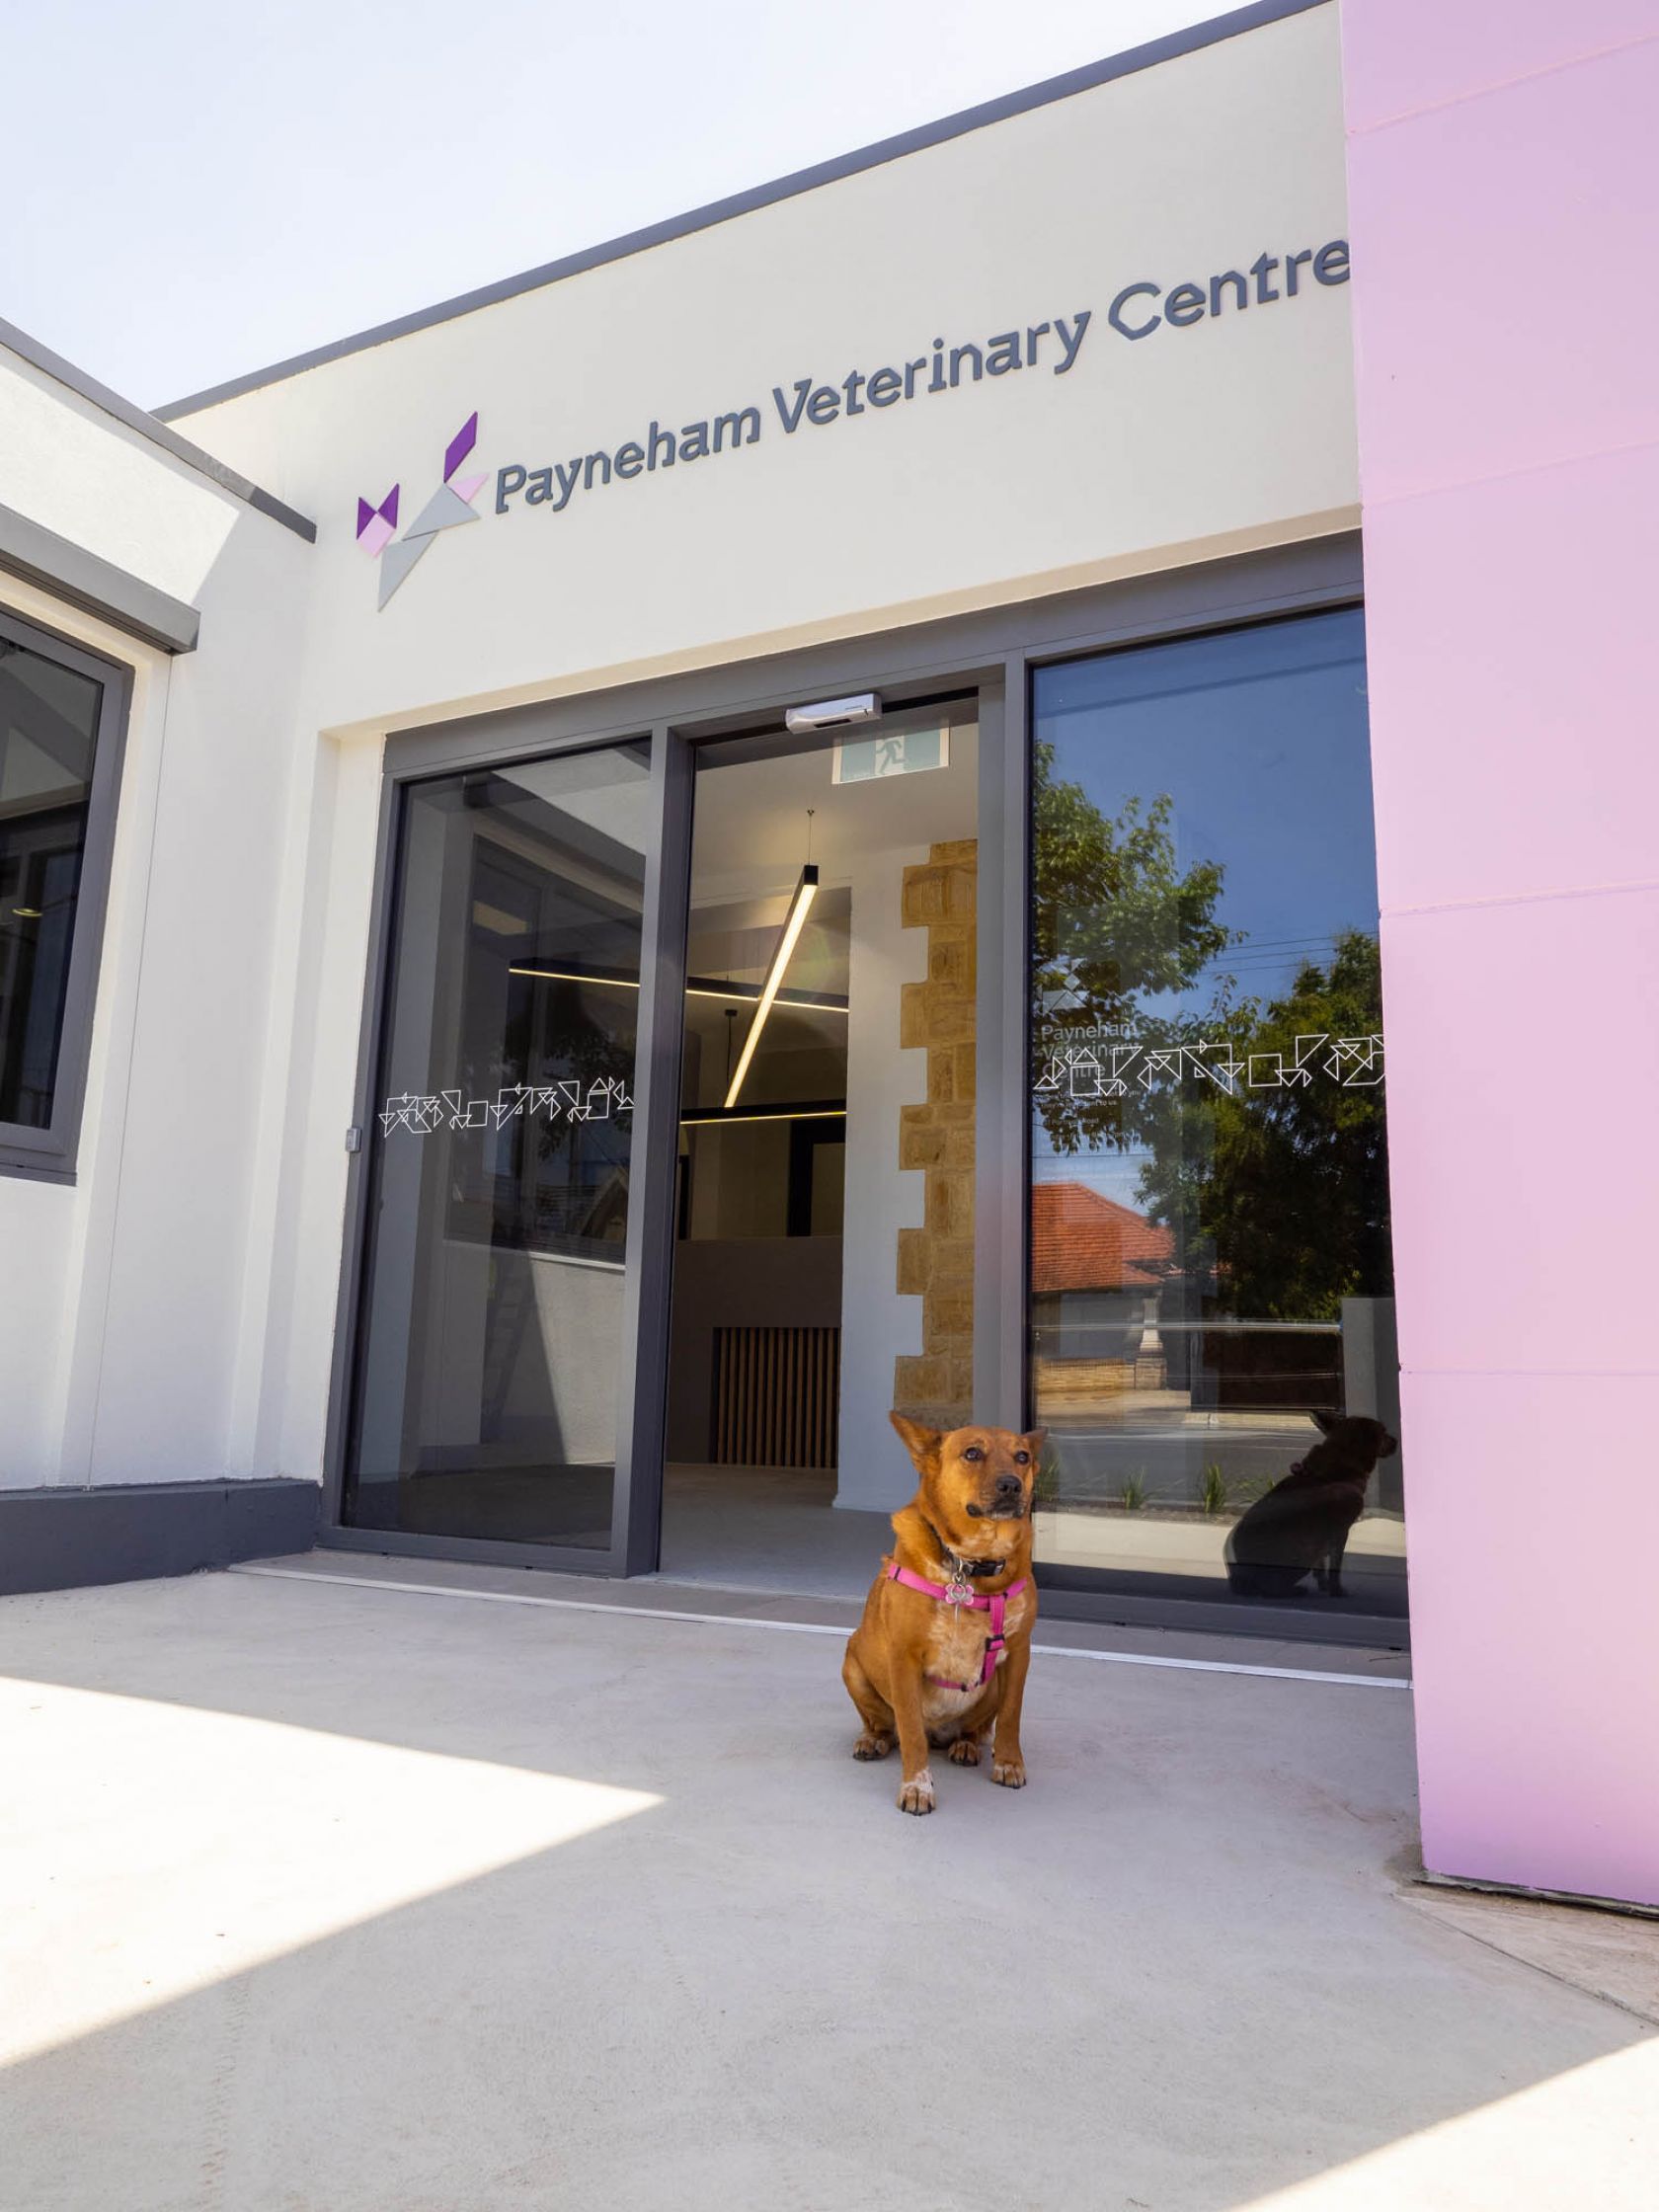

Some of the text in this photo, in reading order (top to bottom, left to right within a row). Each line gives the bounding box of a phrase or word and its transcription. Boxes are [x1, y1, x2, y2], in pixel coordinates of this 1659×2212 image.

[496, 239, 1351, 514] Payneham Veterinary Centre
[1041, 1020, 1137, 1044] Payneham
[1042, 1040, 1141, 1061] Veterinary
